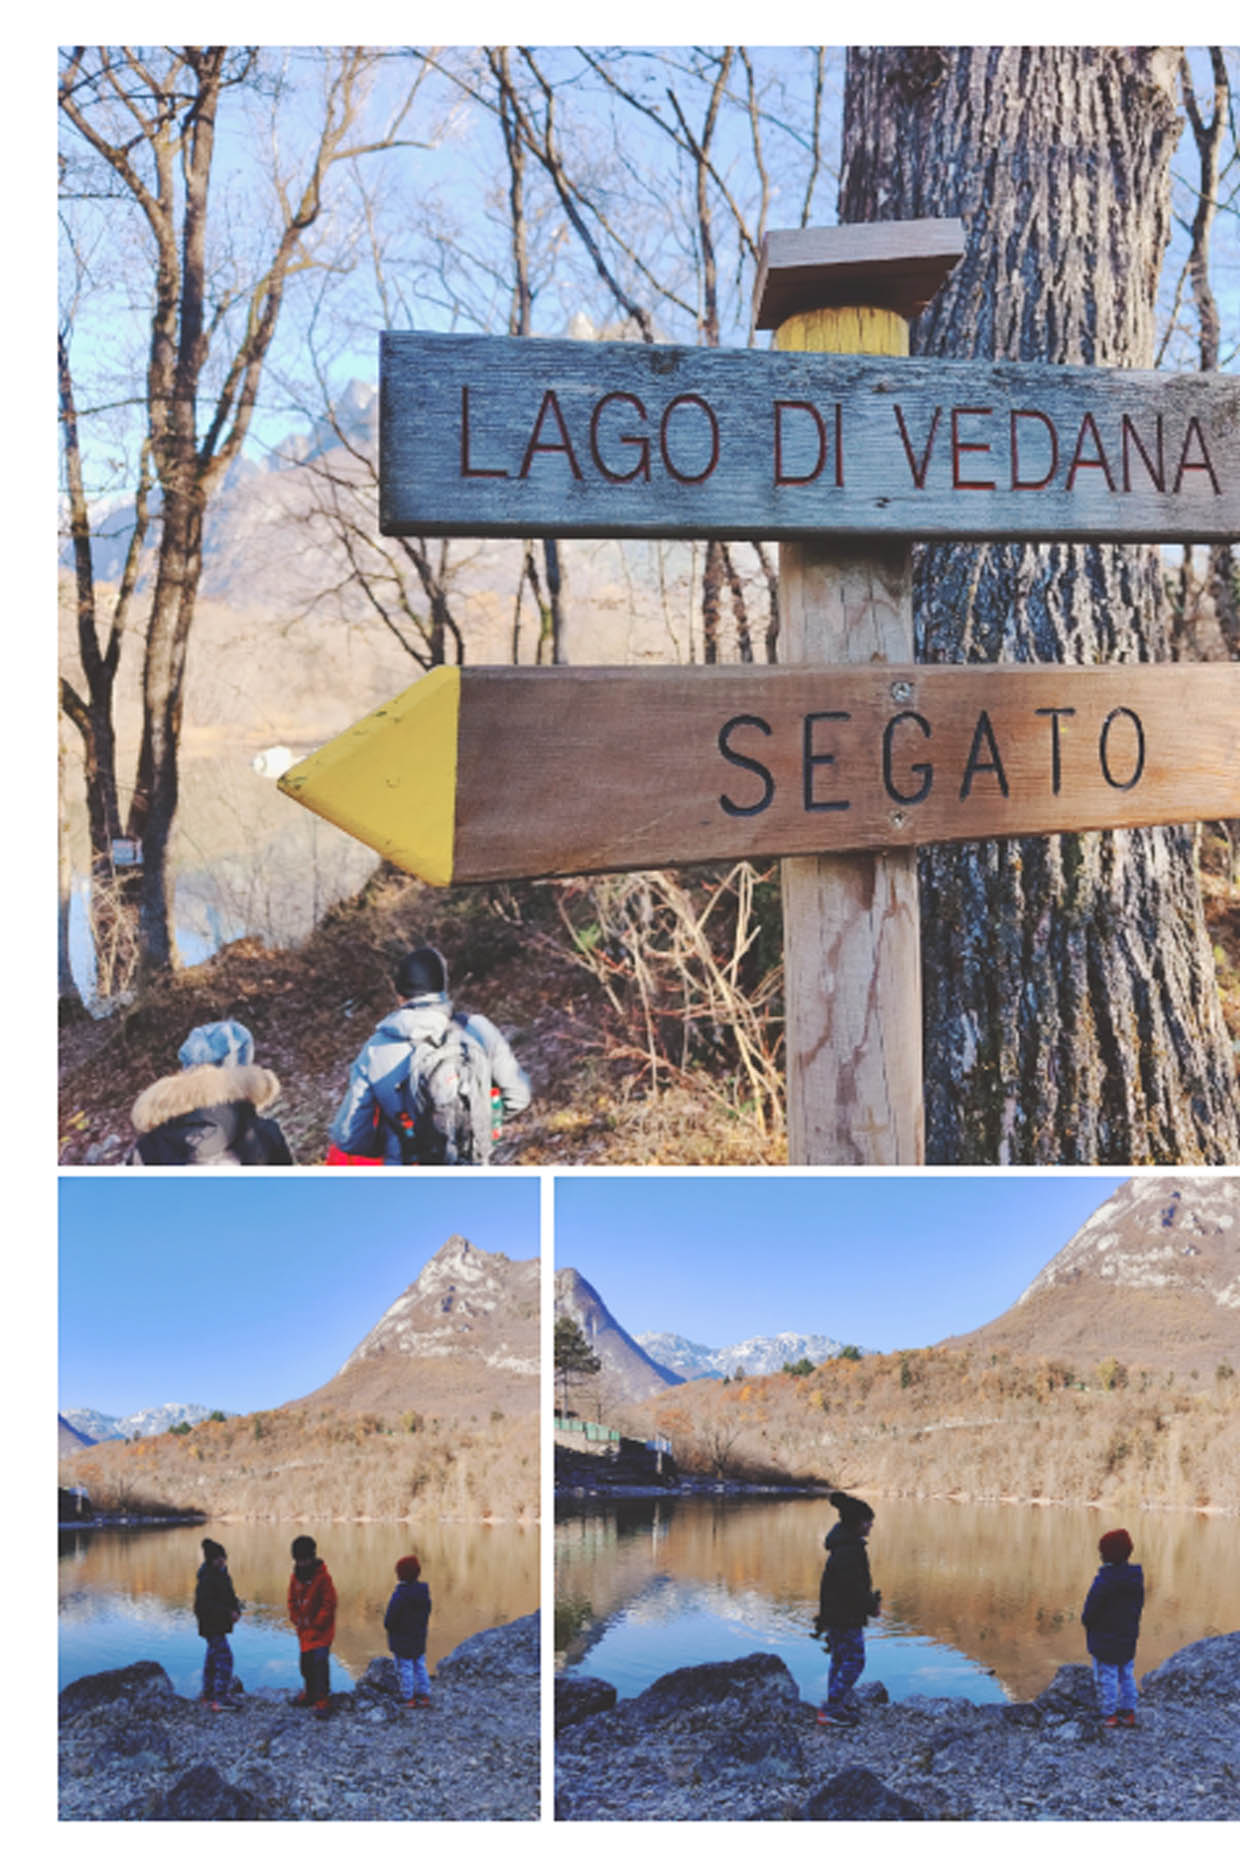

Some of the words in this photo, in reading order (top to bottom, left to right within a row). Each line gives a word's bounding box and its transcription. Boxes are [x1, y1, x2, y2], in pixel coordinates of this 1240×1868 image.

[458, 384, 720, 486] LAGO
[772, 399, 844, 489] DI
[893, 404, 1223, 496] VEDANA
[716, 706, 1146, 818] SEGATO
